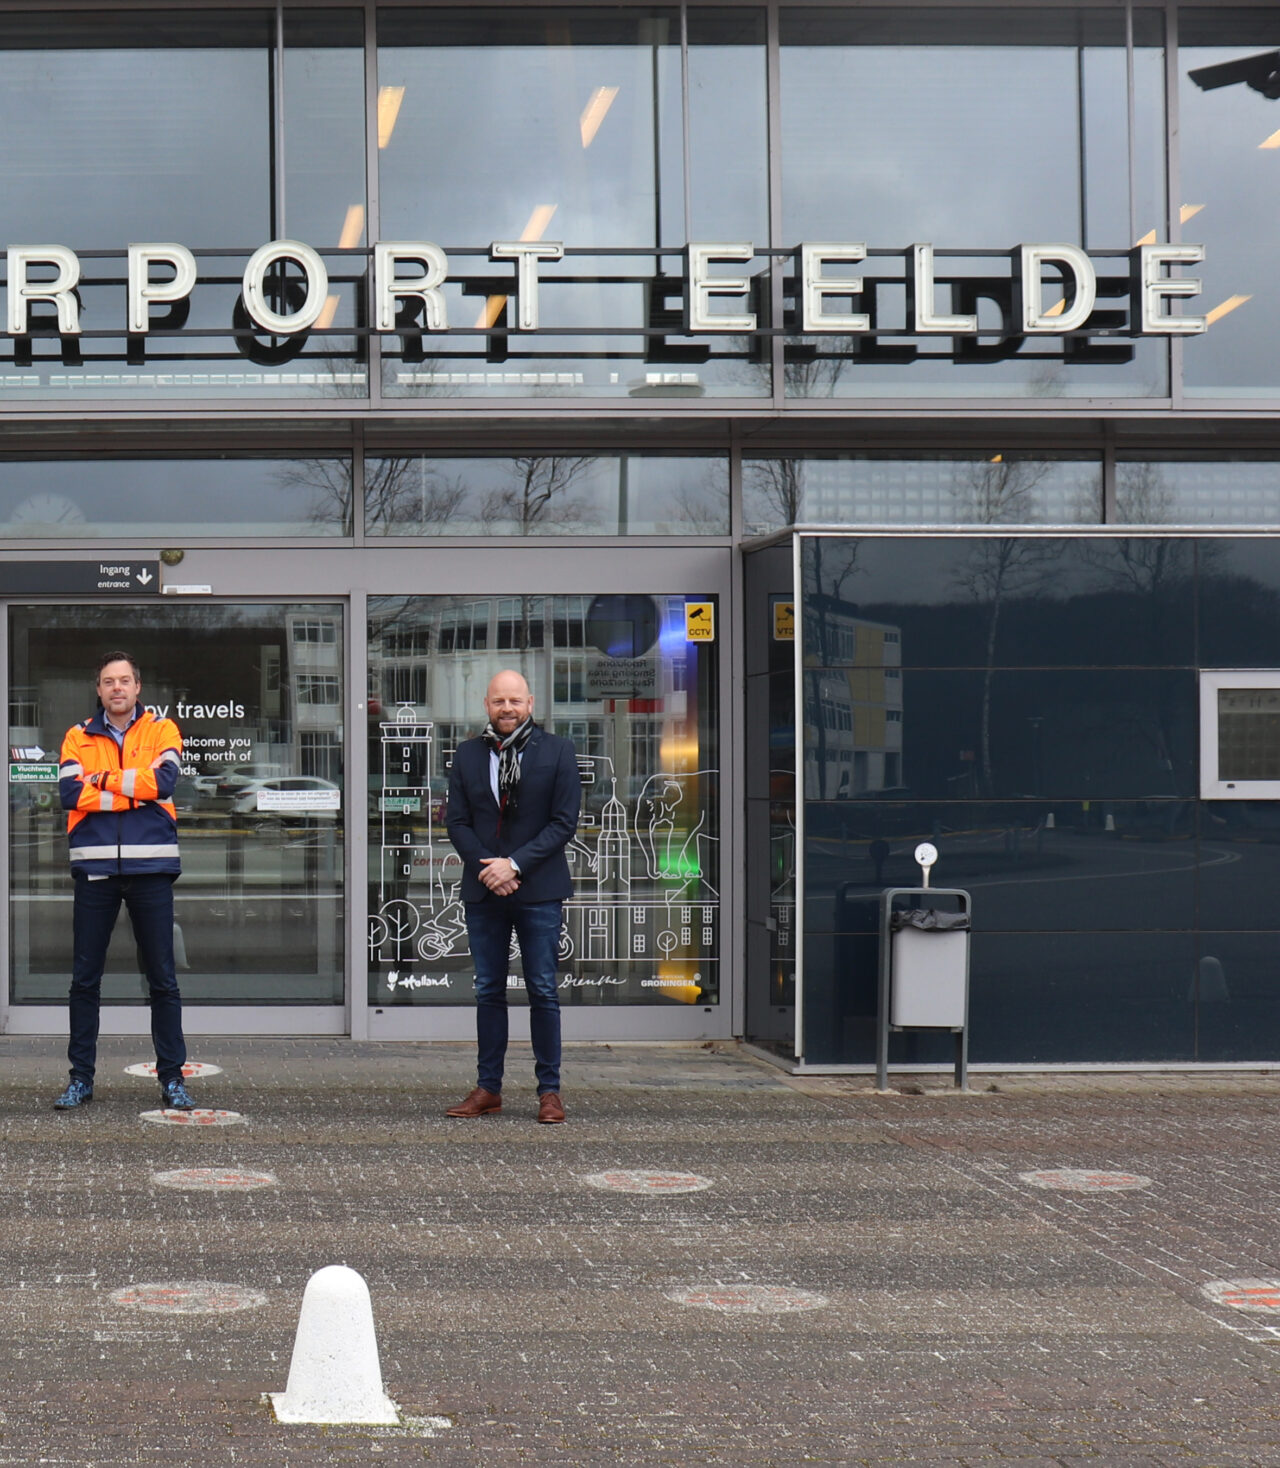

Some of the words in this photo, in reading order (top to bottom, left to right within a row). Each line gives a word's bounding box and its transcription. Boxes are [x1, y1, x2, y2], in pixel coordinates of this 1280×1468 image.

[687, 242, 1208, 334] EELDE
[100, 564, 130, 576] Ingang
[689, 628, 711, 636] CCTV
[177, 700, 245, 719] travels
[180, 736, 226, 748] elcome
[229, 738, 251, 750] you
[181, 750, 201, 762] the
[205, 750, 236, 762] north
[239, 750, 252, 762] of
[17, 765, 52, 773] Vluchtweg
[11, 773, 38, 781] vrijlaten
[641, 979, 696, 987] GRONINGEN
